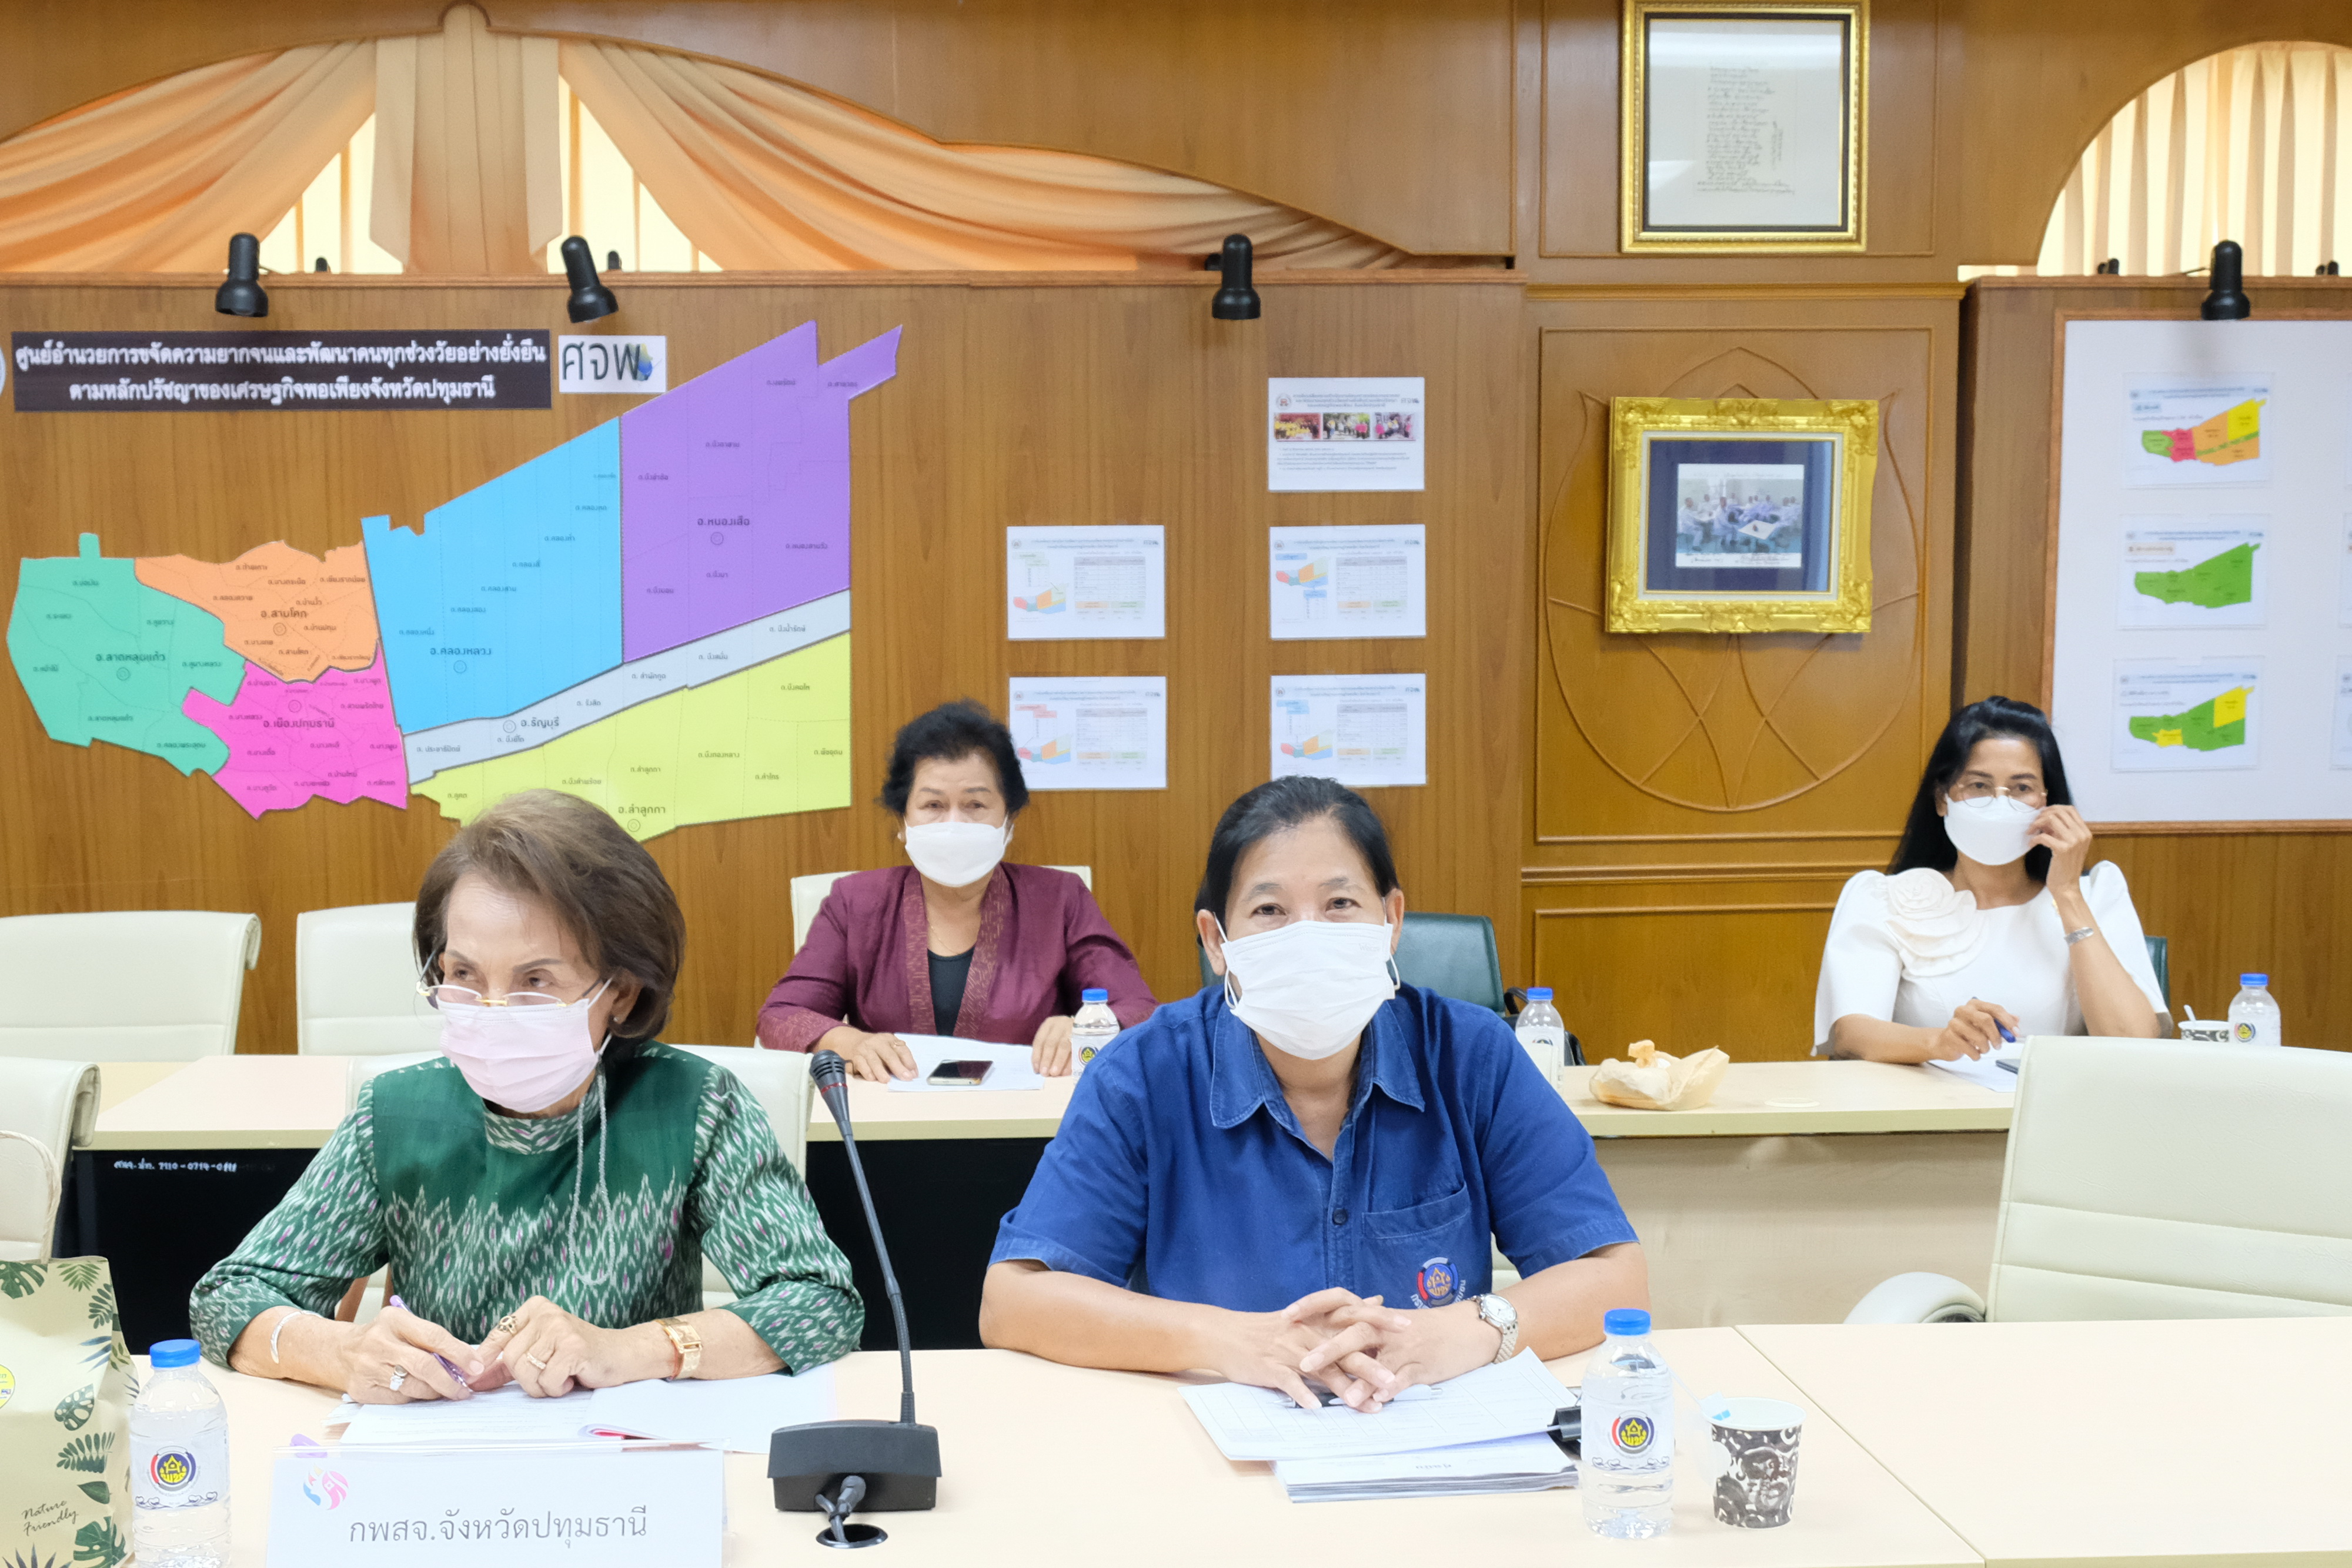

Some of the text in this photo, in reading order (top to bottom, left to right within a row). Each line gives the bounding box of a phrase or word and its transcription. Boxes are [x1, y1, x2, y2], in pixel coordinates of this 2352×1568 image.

[15, 334, 546, 372] ศูนย์อำนวยการขจัดความยากจนและพัฒนาคนทุกช่วงวัยอย่างยั่งยืน
[562, 342, 642, 381] ศจพ
[69, 374, 496, 406] ตามหลักปรัชญาของเศรษฐกิจพอเพียงจังหวัดปทุมธานี
[697, 516, 750, 526] อ.หนองเสือ
[263, 717, 335, 730] อ.เมืองปทุมธานี
[521, 717, 559, 729] อ.ธัญบุรี
[618, 804, 666, 817] อ.ลำลูกกา
[21, 1500, 67, 1519] Nature
[24, 1507, 79, 1536] Friendly
[349, 1505, 648, 1549] กพสจ.จังหวัดปทุมธานี
